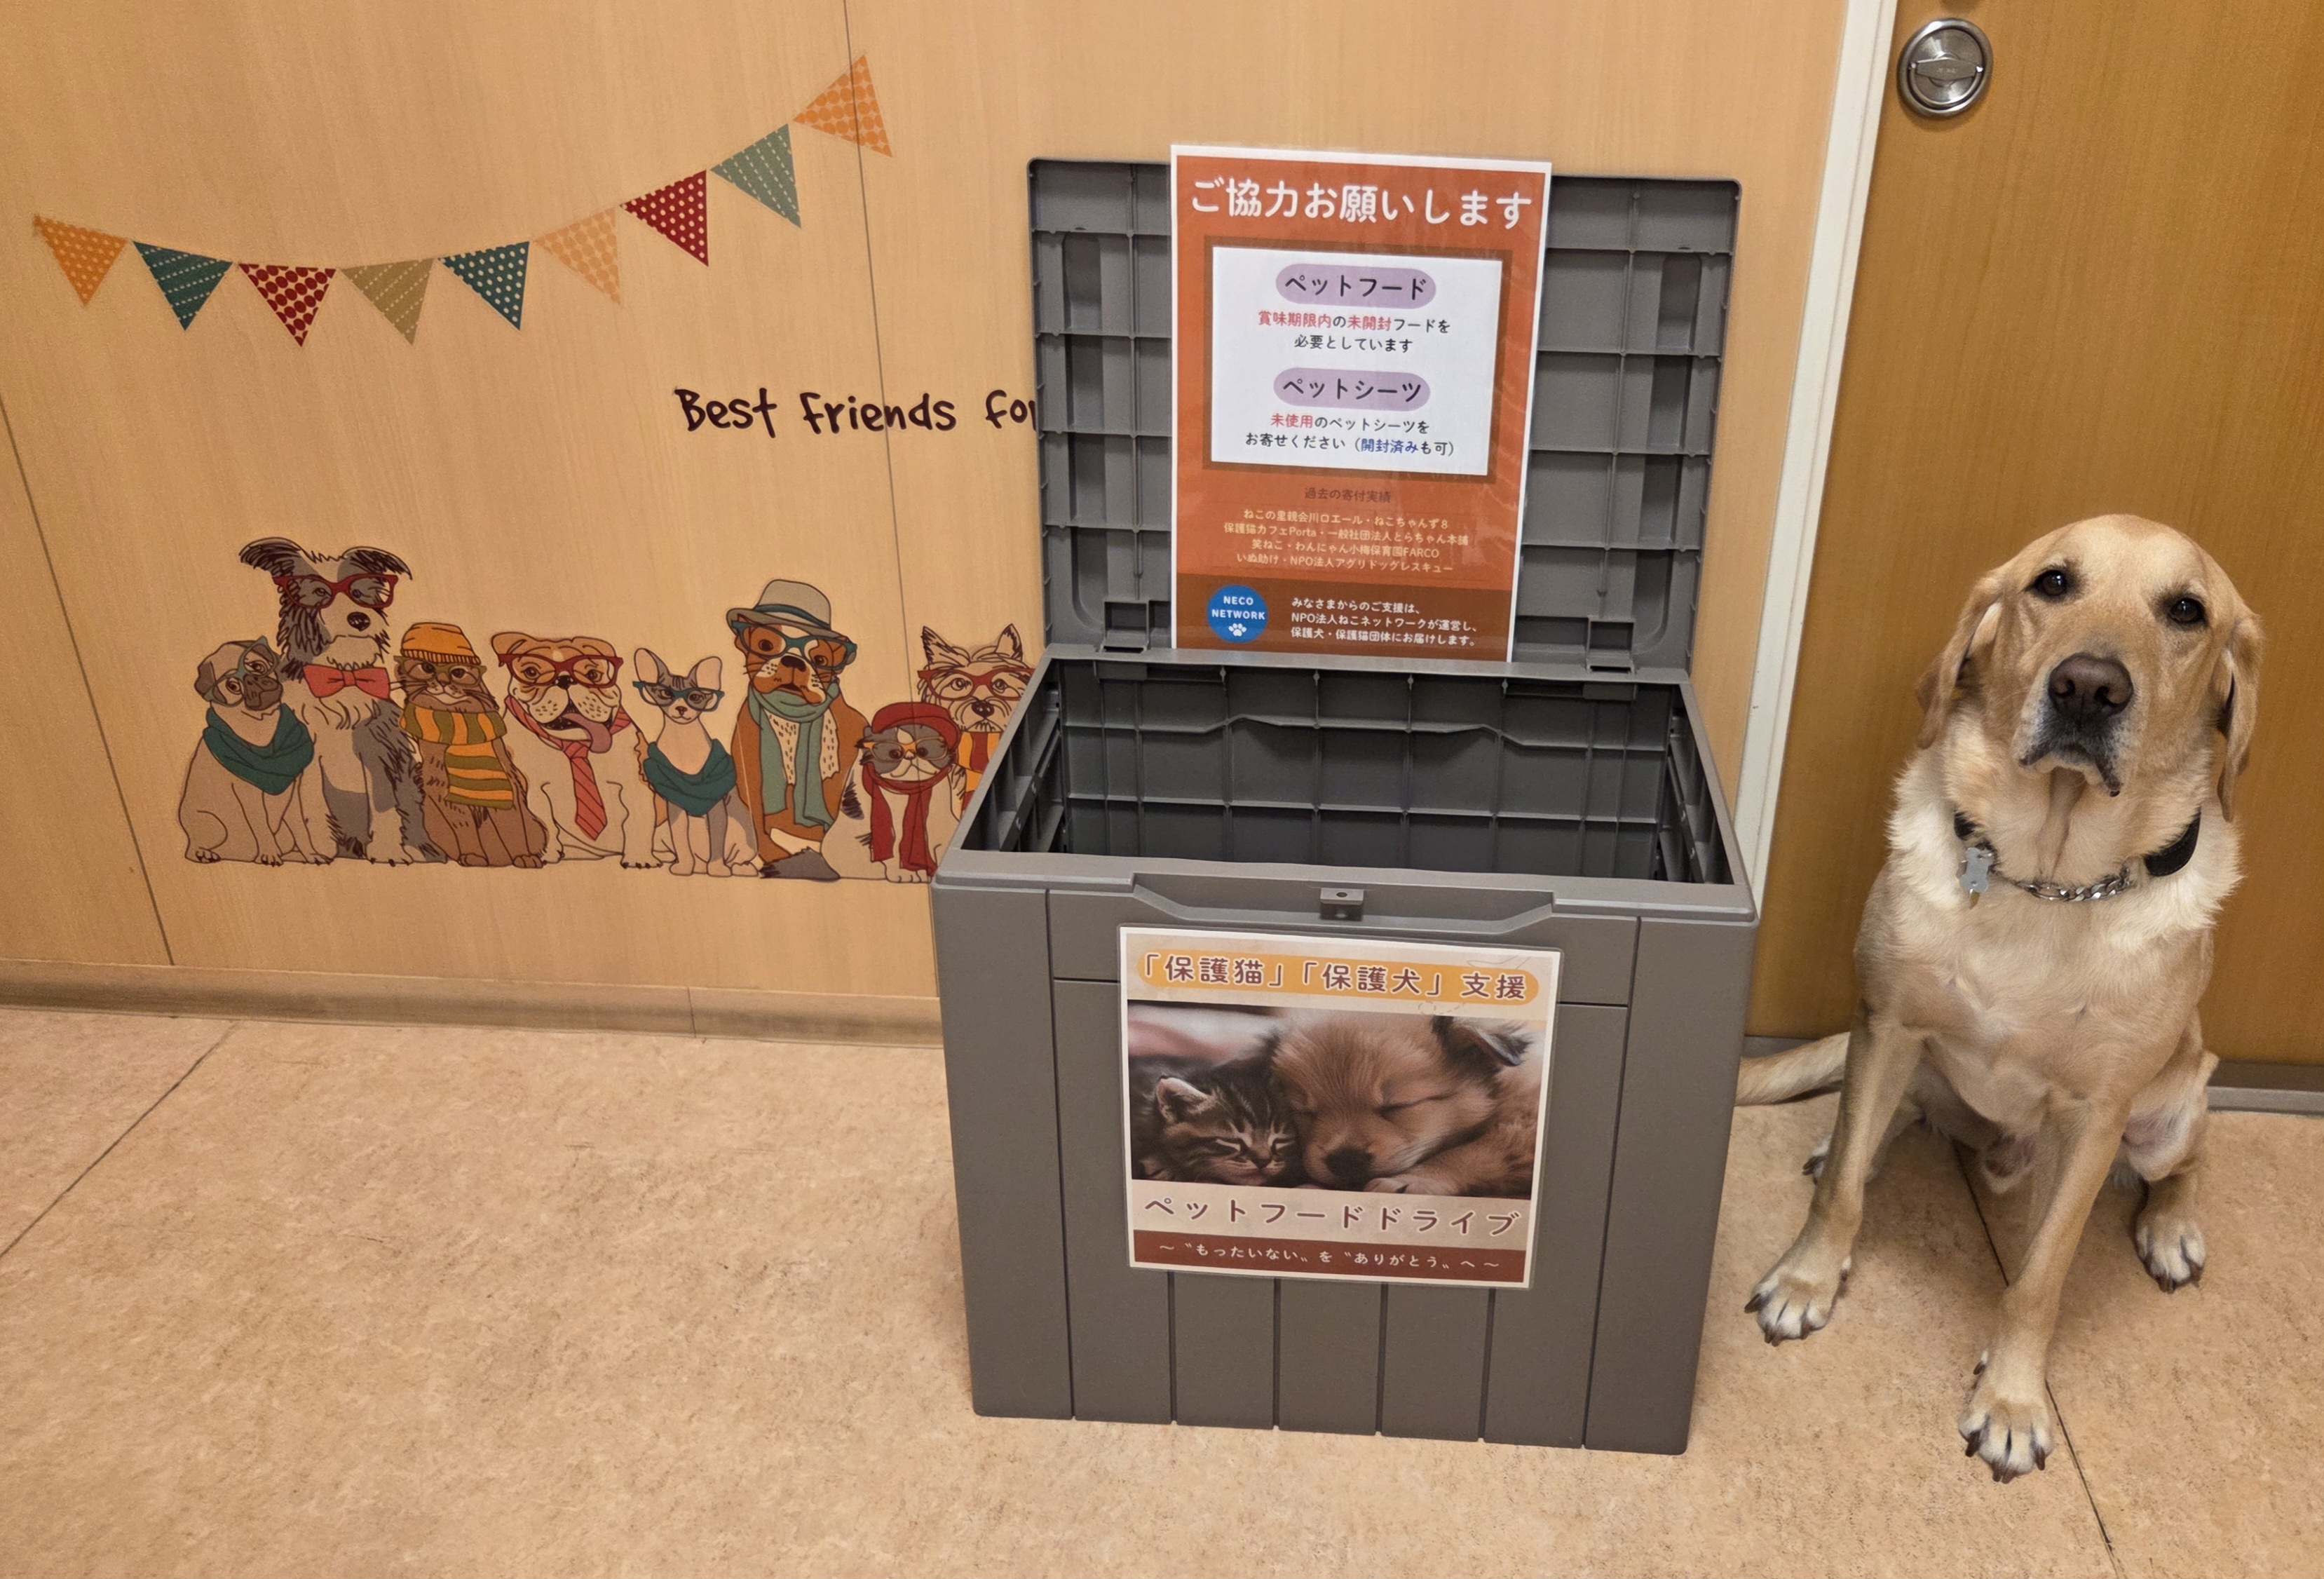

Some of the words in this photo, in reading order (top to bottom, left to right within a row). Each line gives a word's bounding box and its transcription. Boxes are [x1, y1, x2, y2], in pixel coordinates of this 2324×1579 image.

[1192, 177, 1532, 230] ご協力お願いします
[1284, 274, 1427, 300] ペットフード
[1258, 310, 1451, 334] 賞味期限内の未開封フードを
[1294, 334, 1413, 353] 必要としています
[1282, 379, 1422, 402] ペットシーツ
[674, 387, 777, 438] Best
[799, 392, 956, 434] Friends
[1270, 414, 1430, 434] 未使用のペットシーツを
[1245, 433, 1455, 456] お寄せください（開封済みも可）
[1304, 487, 1392, 503] 過去の寄付実績
[1223, 596, 1253, 605] NECO
[1291, 597, 1422, 614] みなさまからのご支援は、
[1211, 609, 1265, 621] NETWORK
[1291, 612, 1477, 632] NPO法人ねこネットワークが運営し、
[1291, 626, 1475, 646] 保護犬・保護猫団体にお届けします。
[1145, 954, 1525, 1001] 「保護猫」「保護犬」支援
[1145, 1198, 1521, 1236] ペットフードドライブ
